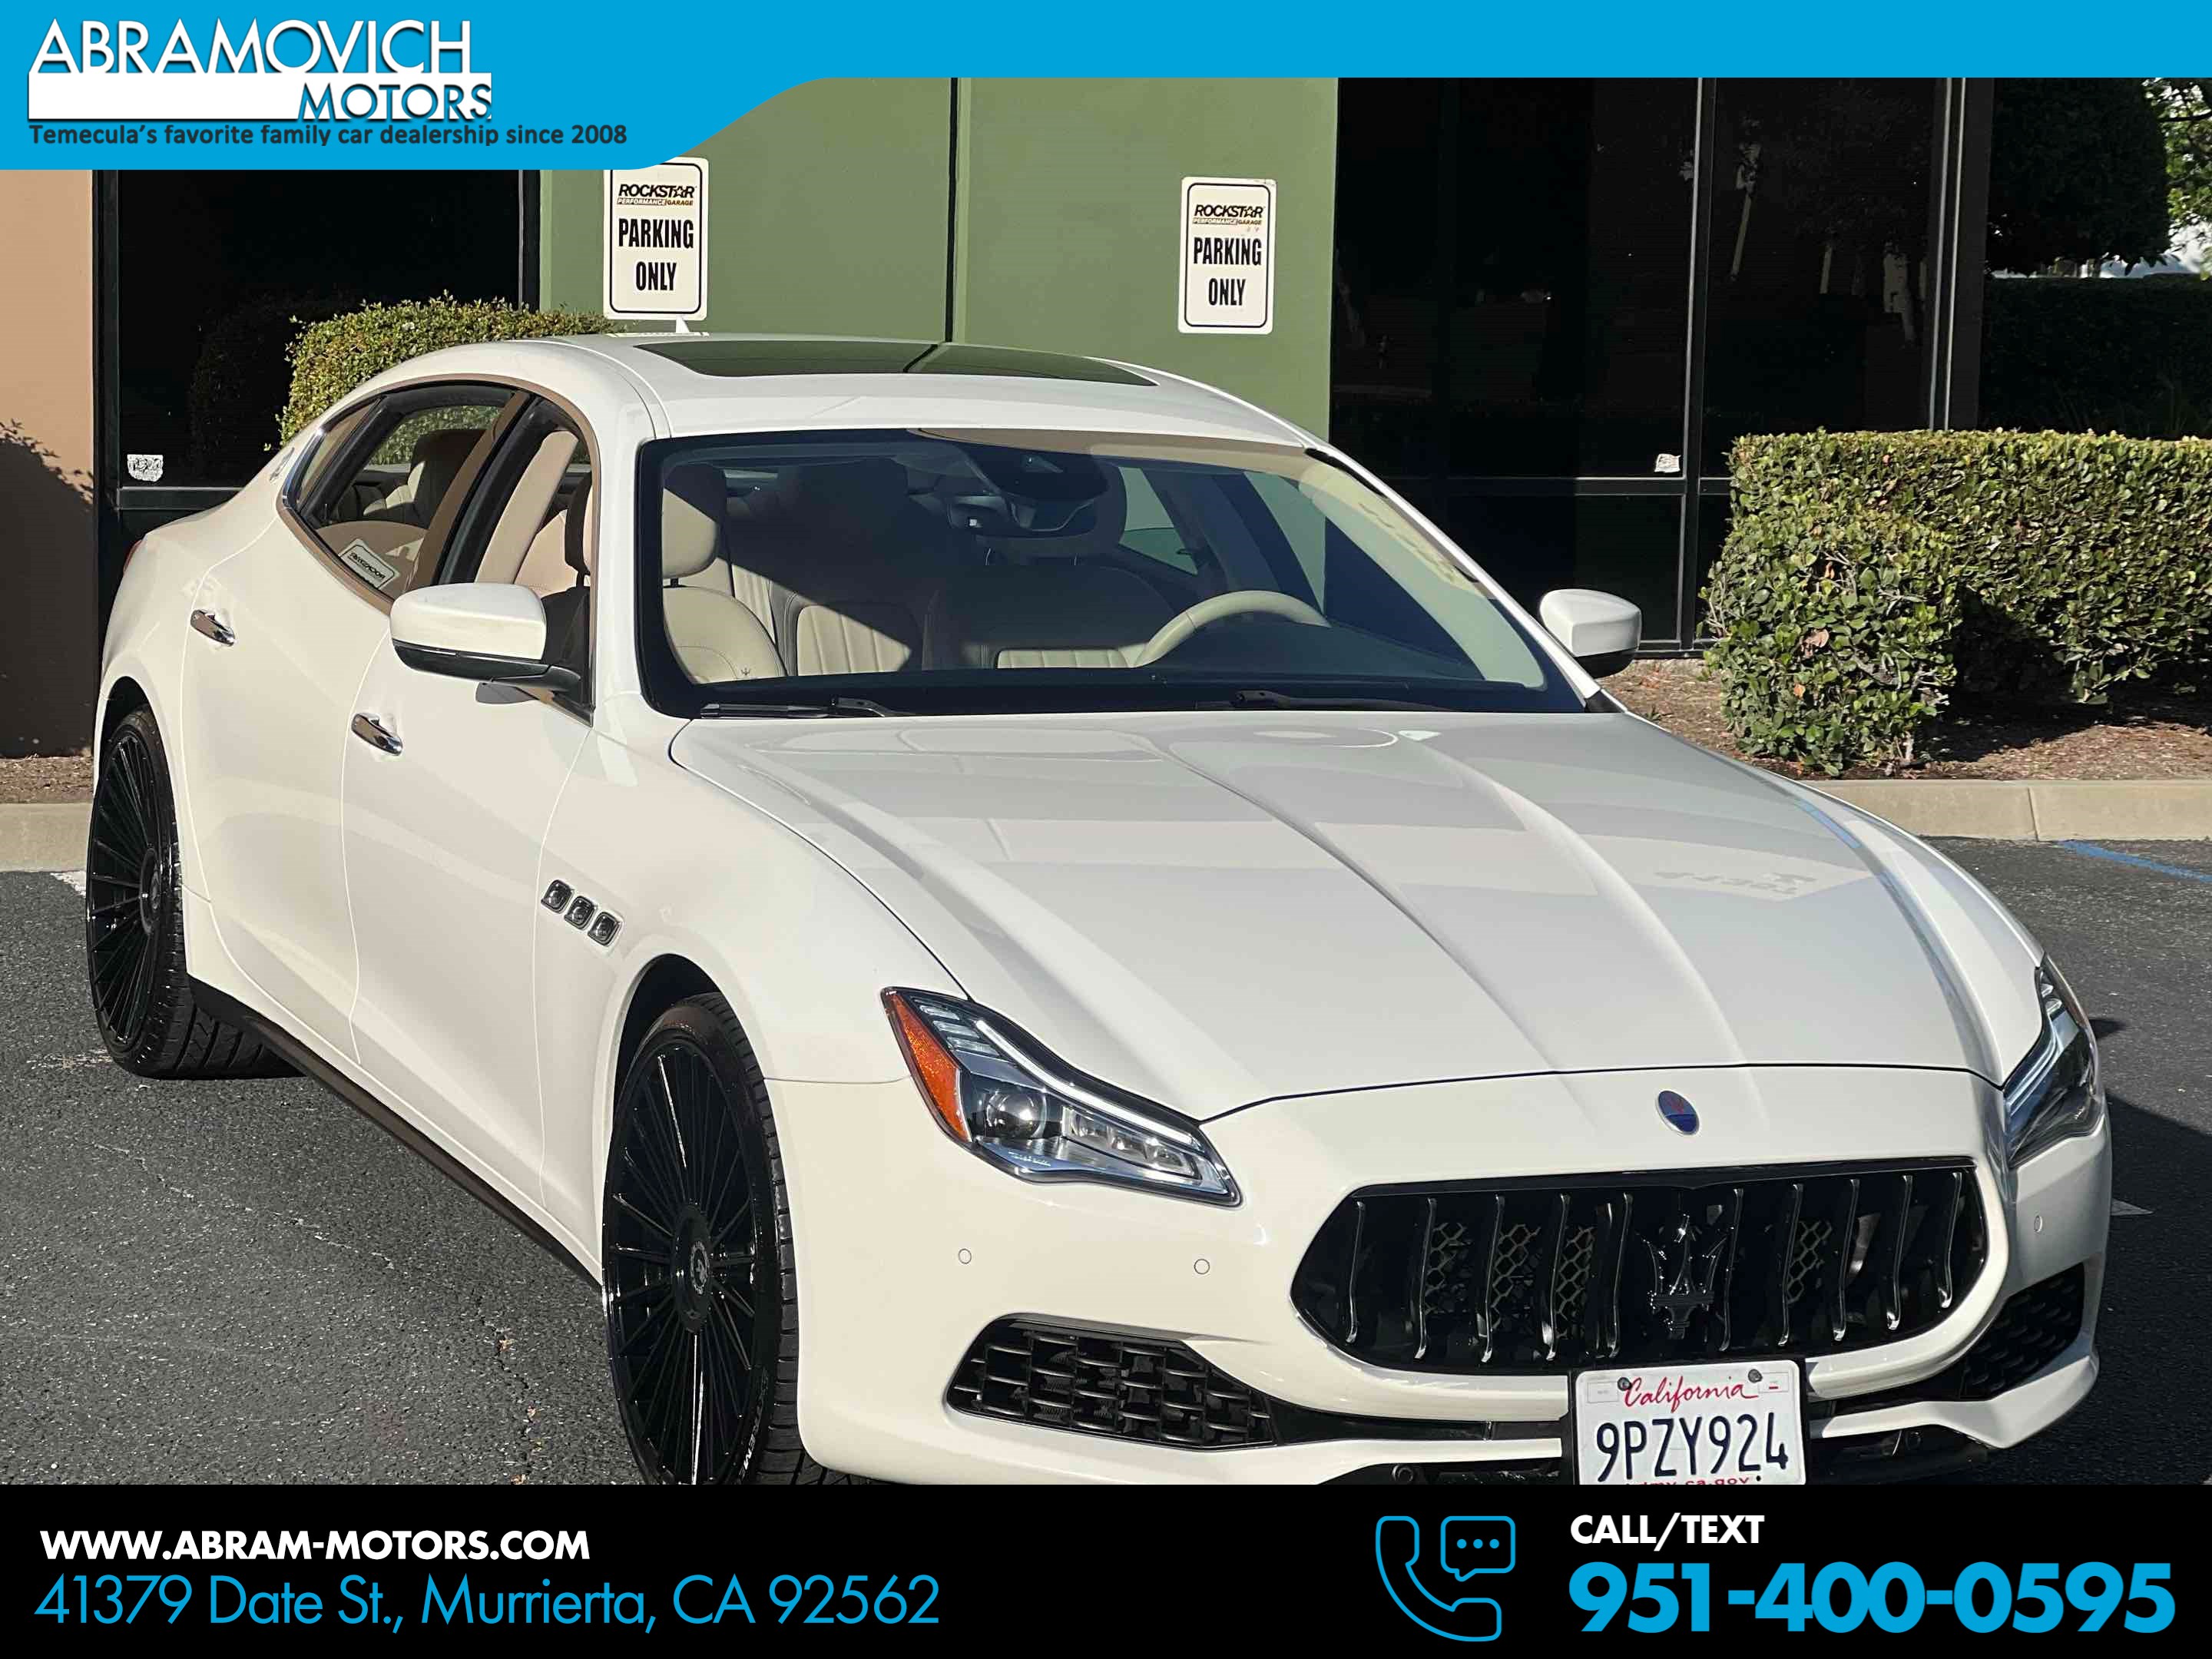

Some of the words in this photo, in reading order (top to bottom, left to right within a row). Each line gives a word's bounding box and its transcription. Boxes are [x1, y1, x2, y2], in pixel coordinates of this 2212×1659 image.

[618, 184, 696, 198] ROCKSTAR
[1194, 204, 1264, 218] ROCKSTAR
[618, 217, 694, 249] PARKING
[1194, 237, 1262, 266] PARKING
[636, 261, 677, 291] ONLY
[1208, 278, 1246, 306] ONLY
[1624, 1376, 1759, 1413] California
[1596, 1412, 1788, 1482] 9PZY924
